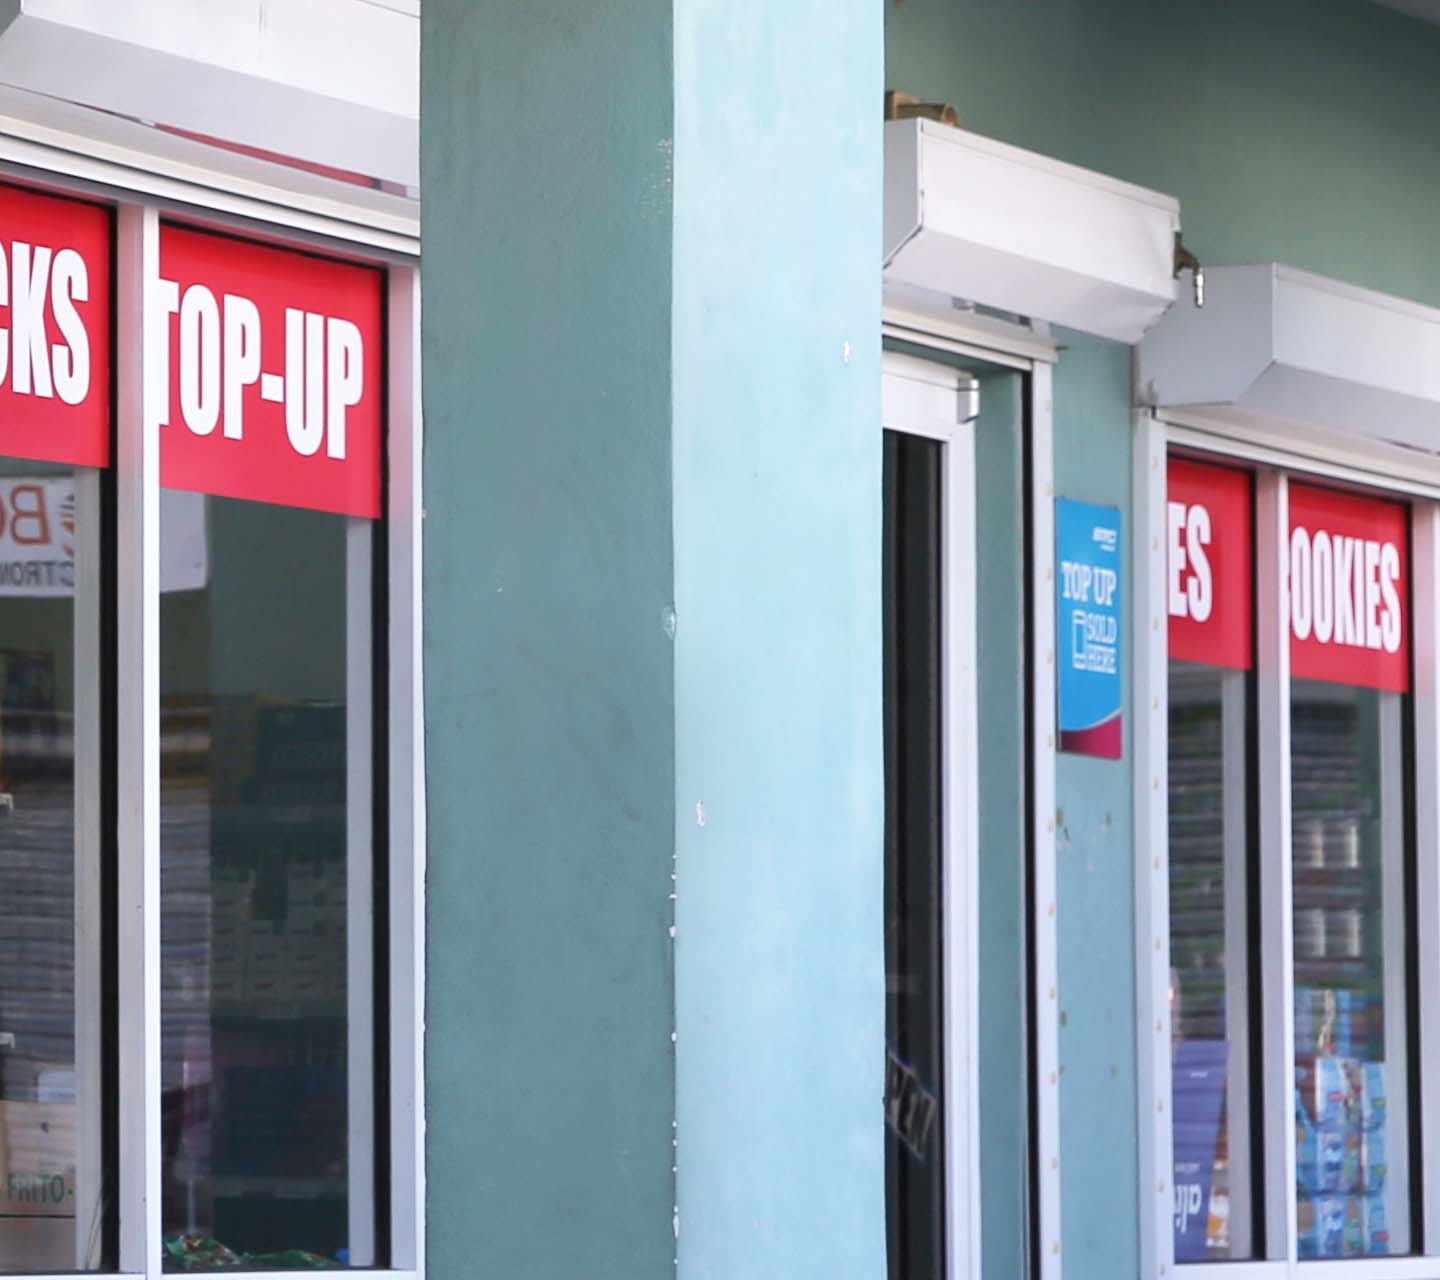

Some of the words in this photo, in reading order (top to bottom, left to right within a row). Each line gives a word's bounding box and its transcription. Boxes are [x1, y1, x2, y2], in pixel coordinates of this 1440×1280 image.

[1061, 560, 1092, 602] TOP
[1093, 566, 1117, 606] UP
[1167, 501, 1213, 623] ES
[1288, 526, 1402, 654] OOKIES
[1086, 612, 1117, 645] SOLD
